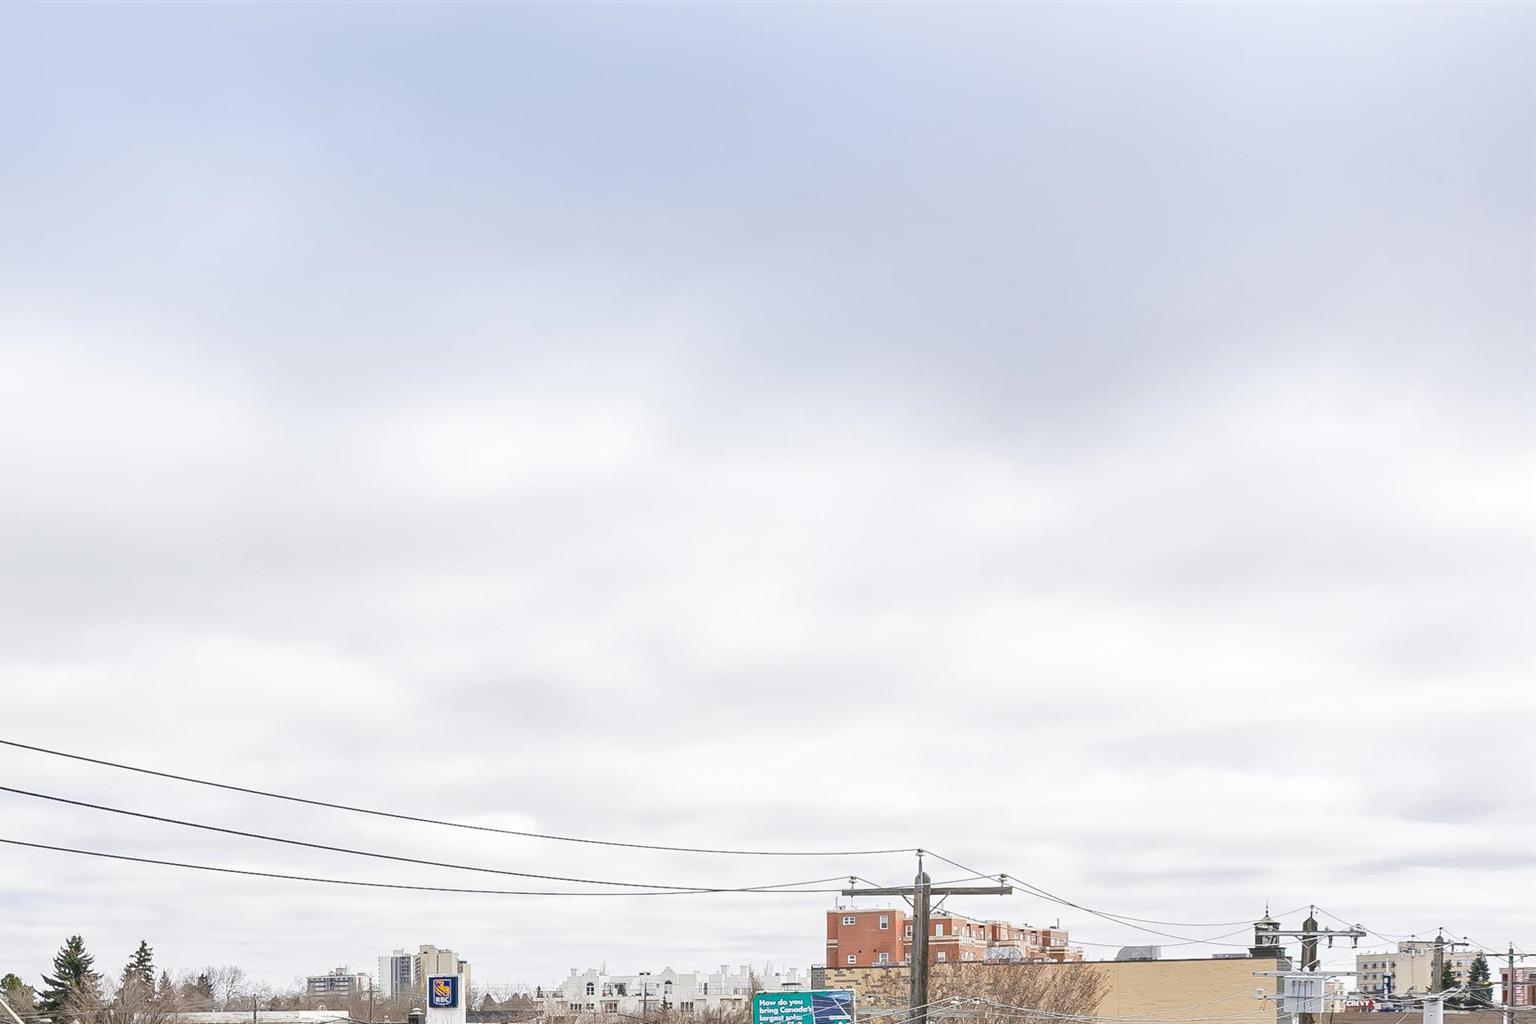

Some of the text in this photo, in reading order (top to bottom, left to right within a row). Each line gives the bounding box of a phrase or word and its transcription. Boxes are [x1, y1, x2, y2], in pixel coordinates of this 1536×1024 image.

[777, 998, 788, 1006] do
[788, 999, 803, 1007] you
[759, 1005, 812, 1015] bring Canada's
[759, 1014, 784, 1023] largest
